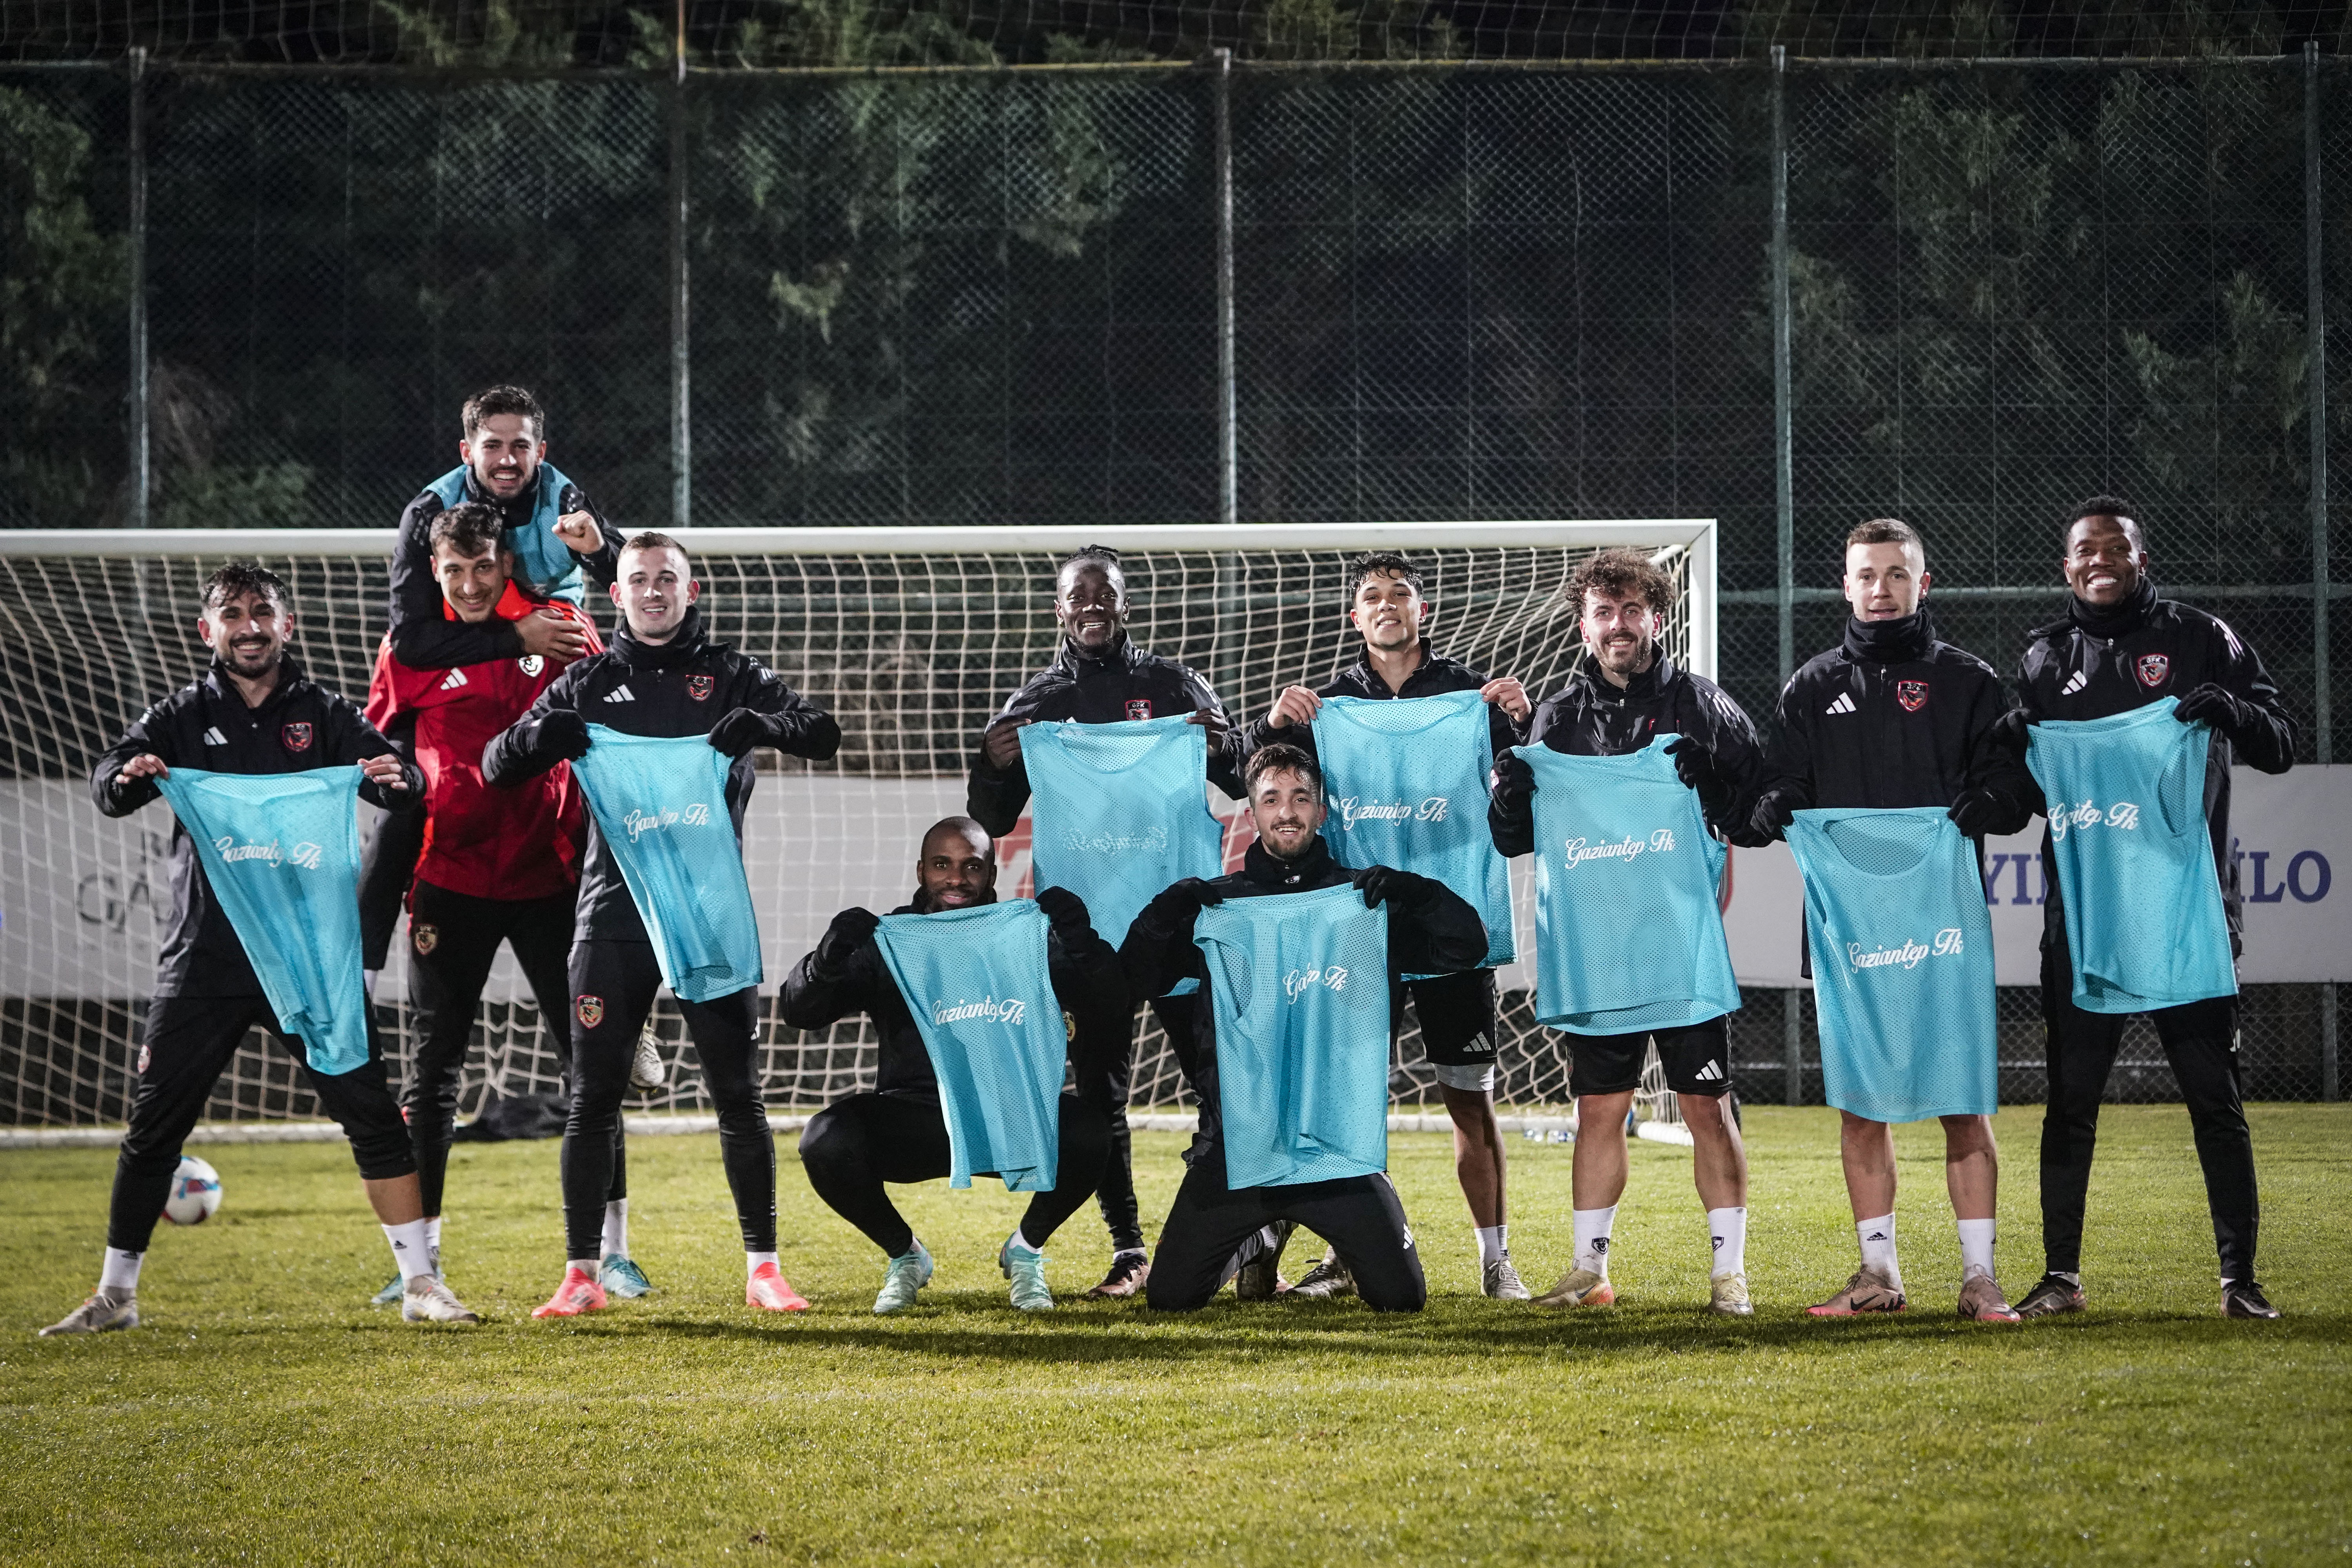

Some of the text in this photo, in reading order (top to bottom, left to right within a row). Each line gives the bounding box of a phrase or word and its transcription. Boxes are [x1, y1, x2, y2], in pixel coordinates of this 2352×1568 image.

[1565, 829, 1676, 869] Gaziantep Fk
[1847, 928, 1964, 974] Gaziantep Fk
